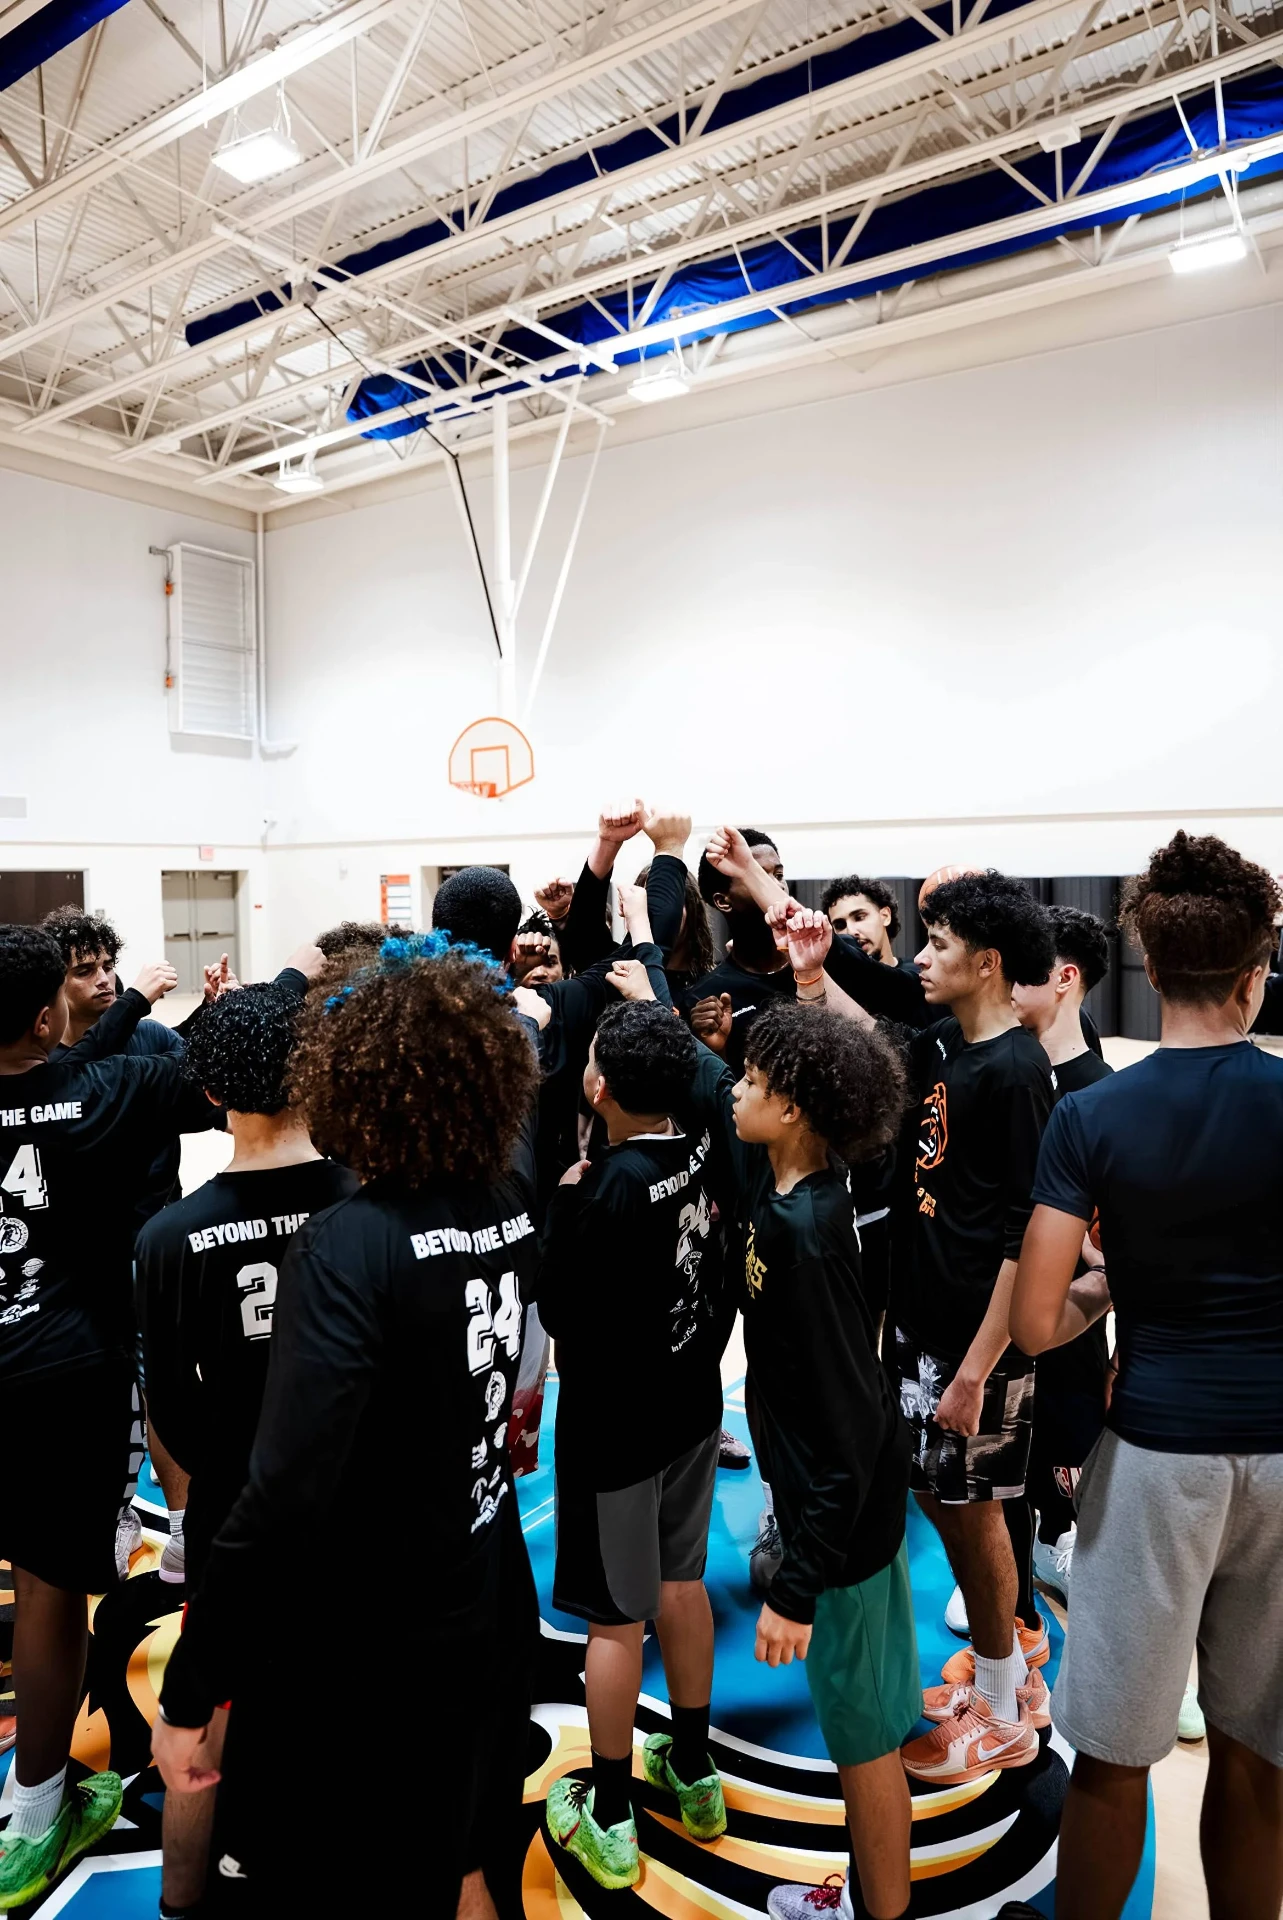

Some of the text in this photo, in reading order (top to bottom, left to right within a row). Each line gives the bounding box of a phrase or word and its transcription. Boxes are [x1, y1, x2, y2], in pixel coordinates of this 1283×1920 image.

[0, 1101, 82, 1127] HE GAME
[0, 1144, 49, 1210] 4
[188, 1219, 268, 1253] BEYOND
[472, 1225, 504, 1255] THE
[501, 1211, 535, 1245] GAME
[465, 1271, 522, 1377] 24
